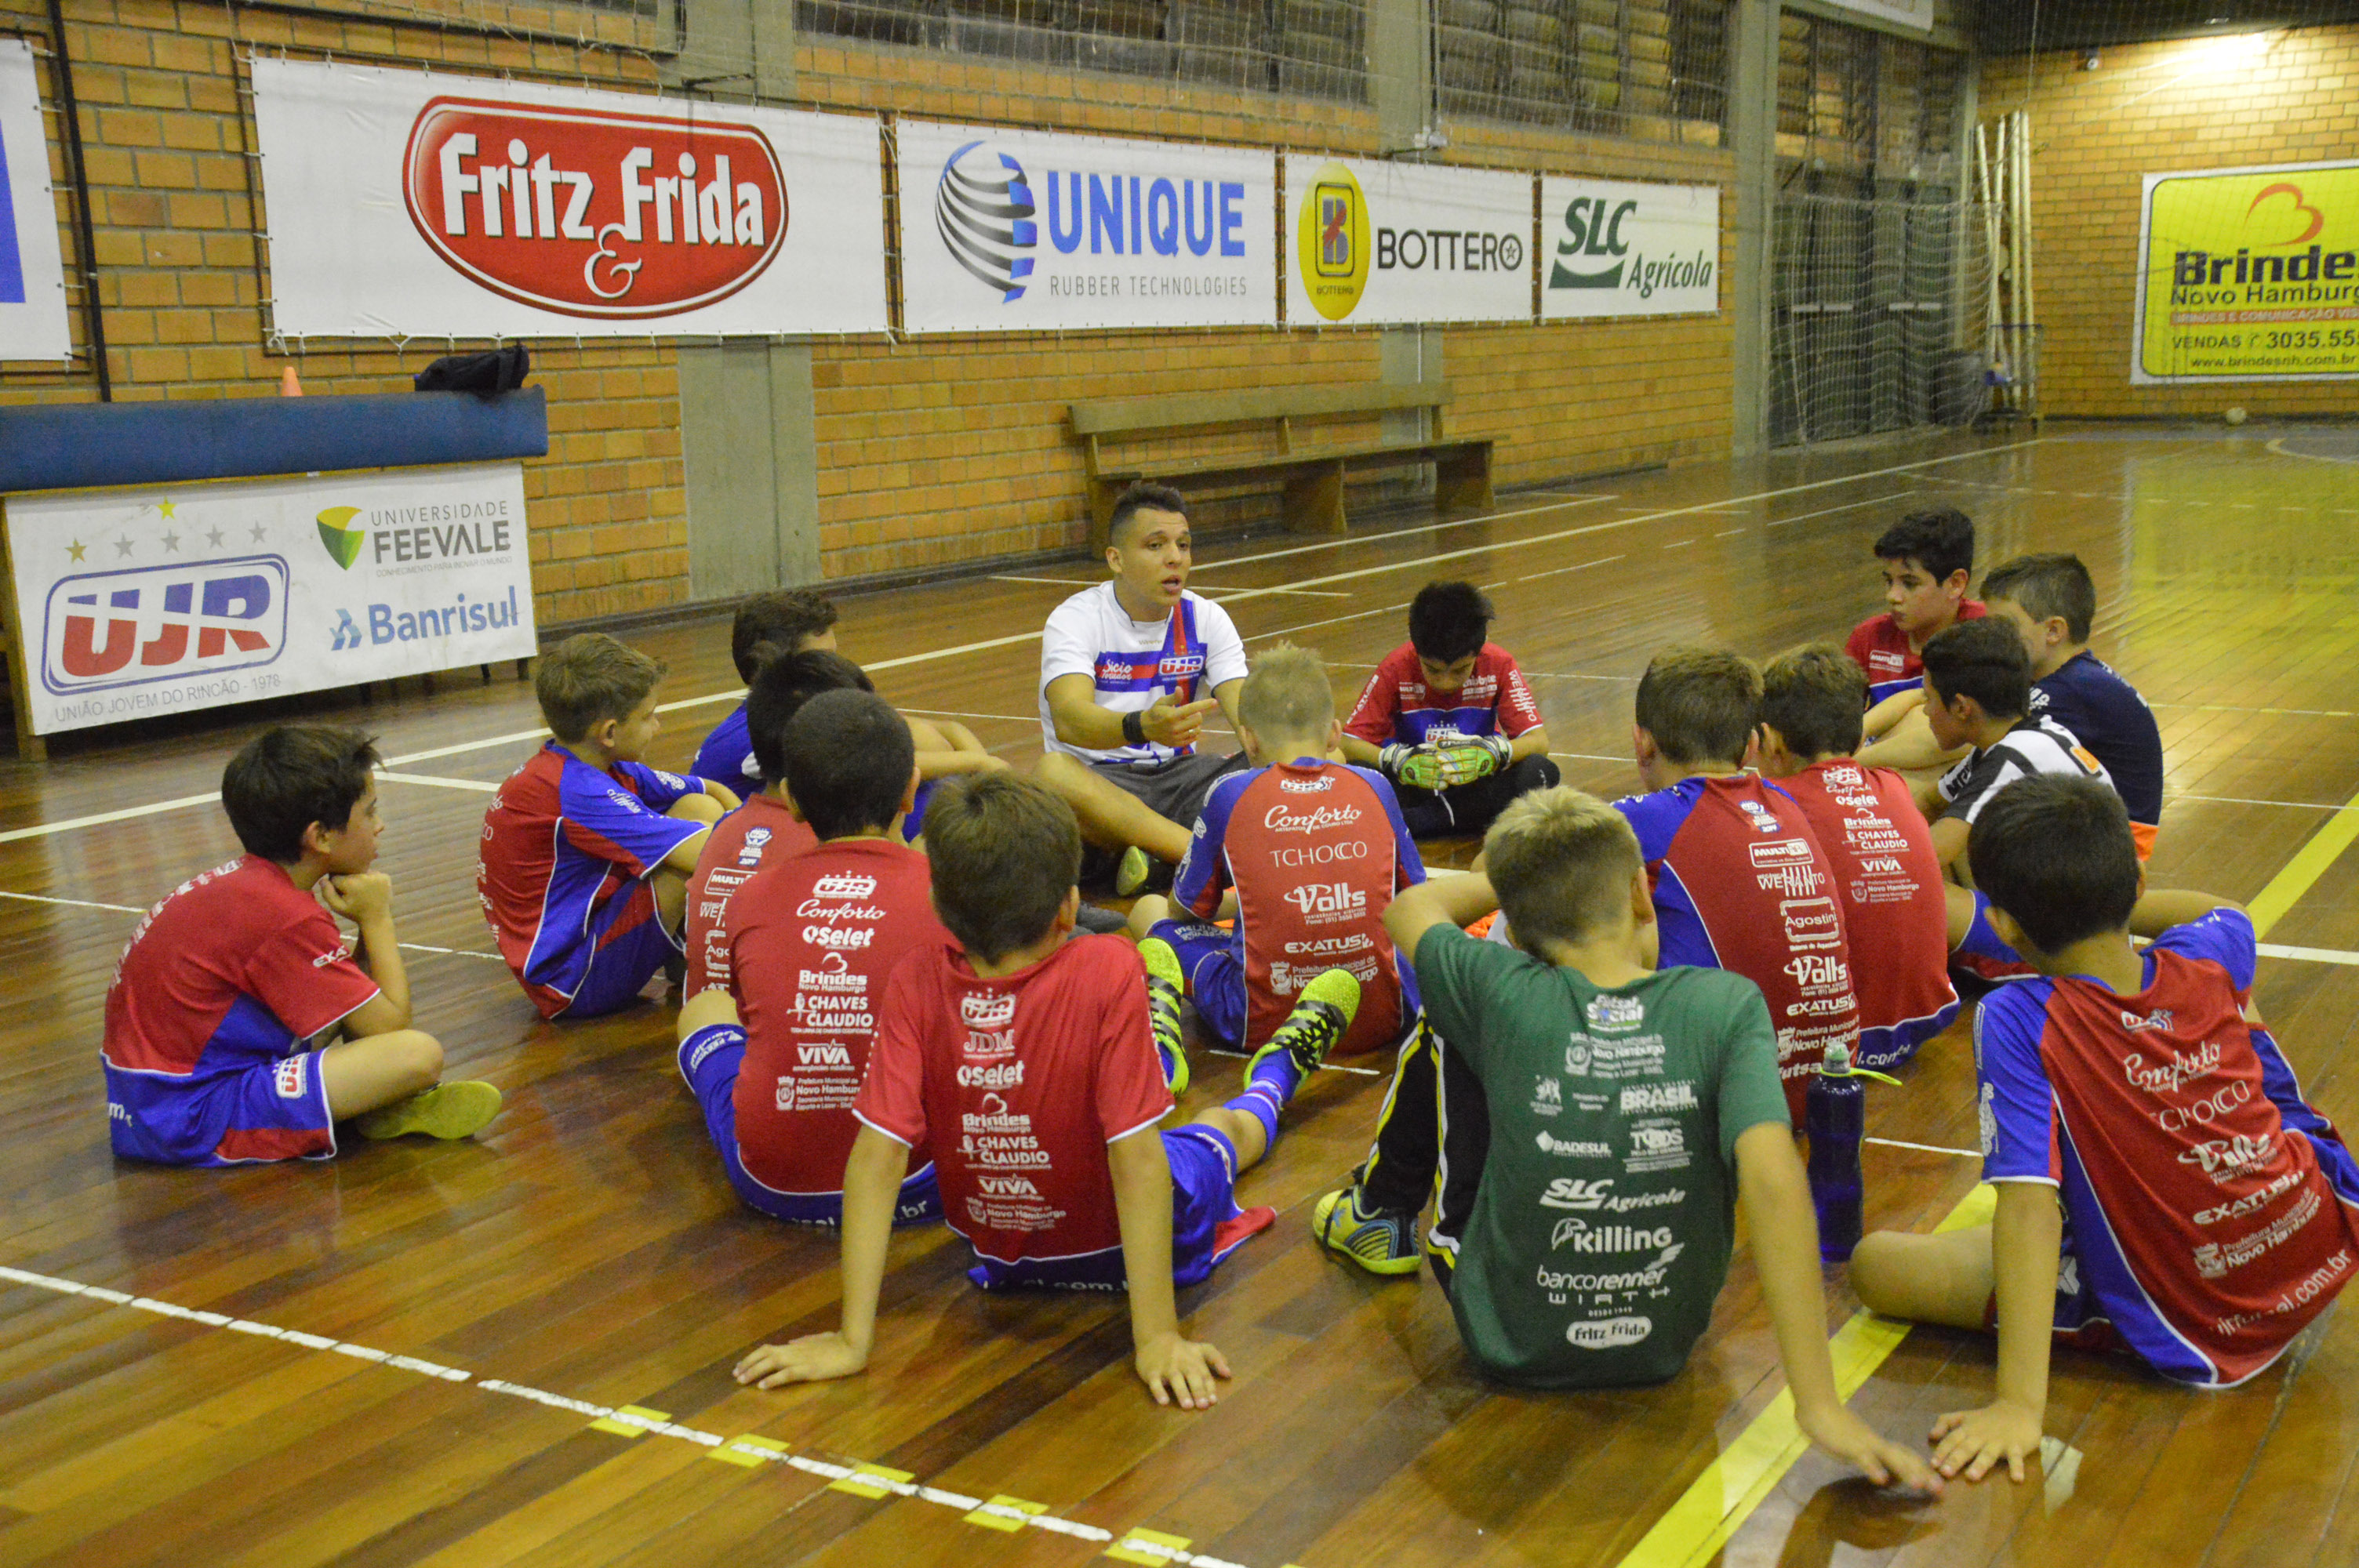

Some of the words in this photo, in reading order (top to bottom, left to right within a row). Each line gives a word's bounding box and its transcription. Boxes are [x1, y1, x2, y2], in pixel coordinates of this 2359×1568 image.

[439, 132, 595, 241] Fritz
[620, 147, 765, 247] Frida
[1047, 169, 1245, 257] UNIQUE
[1557, 196, 1637, 256] SLC
[1377, 227, 1523, 270] BOTTERO
[2173, 245, 2359, 286] Brinde
[1050, 275, 1121, 296] RUBBER
[1129, 276, 1247, 296] TECHNOLOGIES
[2171, 287, 2237, 305] Novo
[2172, 335, 2242, 349] VENDAS
[2266, 329, 2359, 349] 3035.55
[371, 501, 508, 526] UNIVERSIDADE
[373, 520, 511, 564] FEEVALE
[368, 585, 519, 644] Banrisul
[62, 575, 271, 677] UJR
[55, 701, 104, 723] UNIÃO
[107, 693, 157, 714] JOVEM
[162, 688, 184, 705] DO
[252, 673, 282, 690] 1978
[1264, 804, 1362, 835] Conforto
[1844, 818, 1892, 826] Brindes
[1857, 829, 1900, 840] CHAVES
[1861, 839, 1908, 850] CLAUDIO
[1861, 858, 1902, 872] VIVA
[1285, 882, 1366, 914] Volts
[796, 898, 887, 925] Conforto
[1785, 913, 1837, 928] Agostini
[1285, 934, 1362, 953] EXATUS
[799, 969, 868, 985] Brindes
[1784, 956, 1847, 985] Volts
[808, 995, 869, 1011] CHAVES
[1787, 996, 1849, 1016] EXATUS
[806, 1012, 874, 1028] CLAUDIO
[963, 1029, 1016, 1053] JDM
[1793, 1039, 1819, 1052] Novo
[797, 1046, 851, 1065] VIVA
[796, 1085, 820, 1095] Novo
[1619, 1083, 1698, 1113] BRASIL
[961, 1112, 1030, 1128] Brindes
[976, 1135, 1039, 1149] CHAVES
[1553, 1139, 1612, 1156] BADESUL
[980, 1150, 1050, 1164] CLAUDIO
[977, 1178, 1039, 1195] VIVA
[1545, 1178, 1615, 1200] SLC
[2226, 1243, 2266, 1269] Novo
